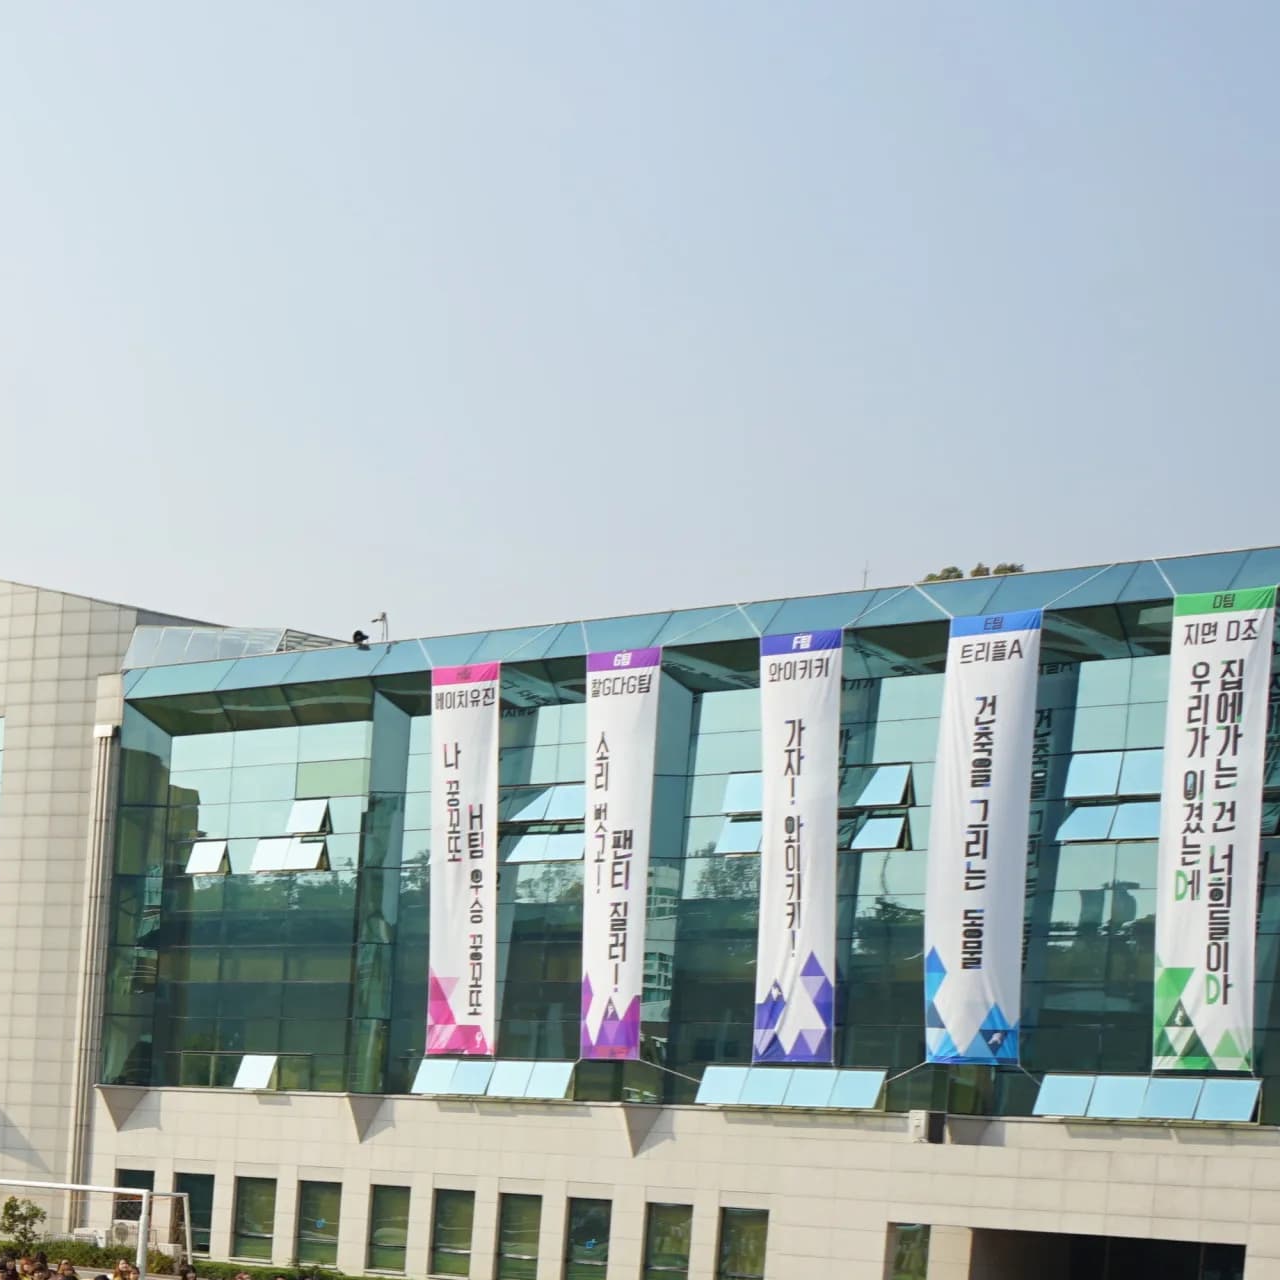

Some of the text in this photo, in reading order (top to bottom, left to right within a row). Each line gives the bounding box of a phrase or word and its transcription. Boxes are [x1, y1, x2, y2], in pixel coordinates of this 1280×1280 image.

[768, 657, 830, 683] 와이키키
[960, 639, 1024, 664] 트리플A
[1185, 661, 1210, 758] 우리가
[443, 742, 461, 769] 나
[594, 731, 609, 791] 소리
[468, 803, 484, 859] H팀
[961, 695, 998, 970] 건축을 그리는 동물
[1212, 800, 1236, 833] 건
[469, 868, 483, 925] 우승
[608, 829, 633, 993] 팬티 질러!
